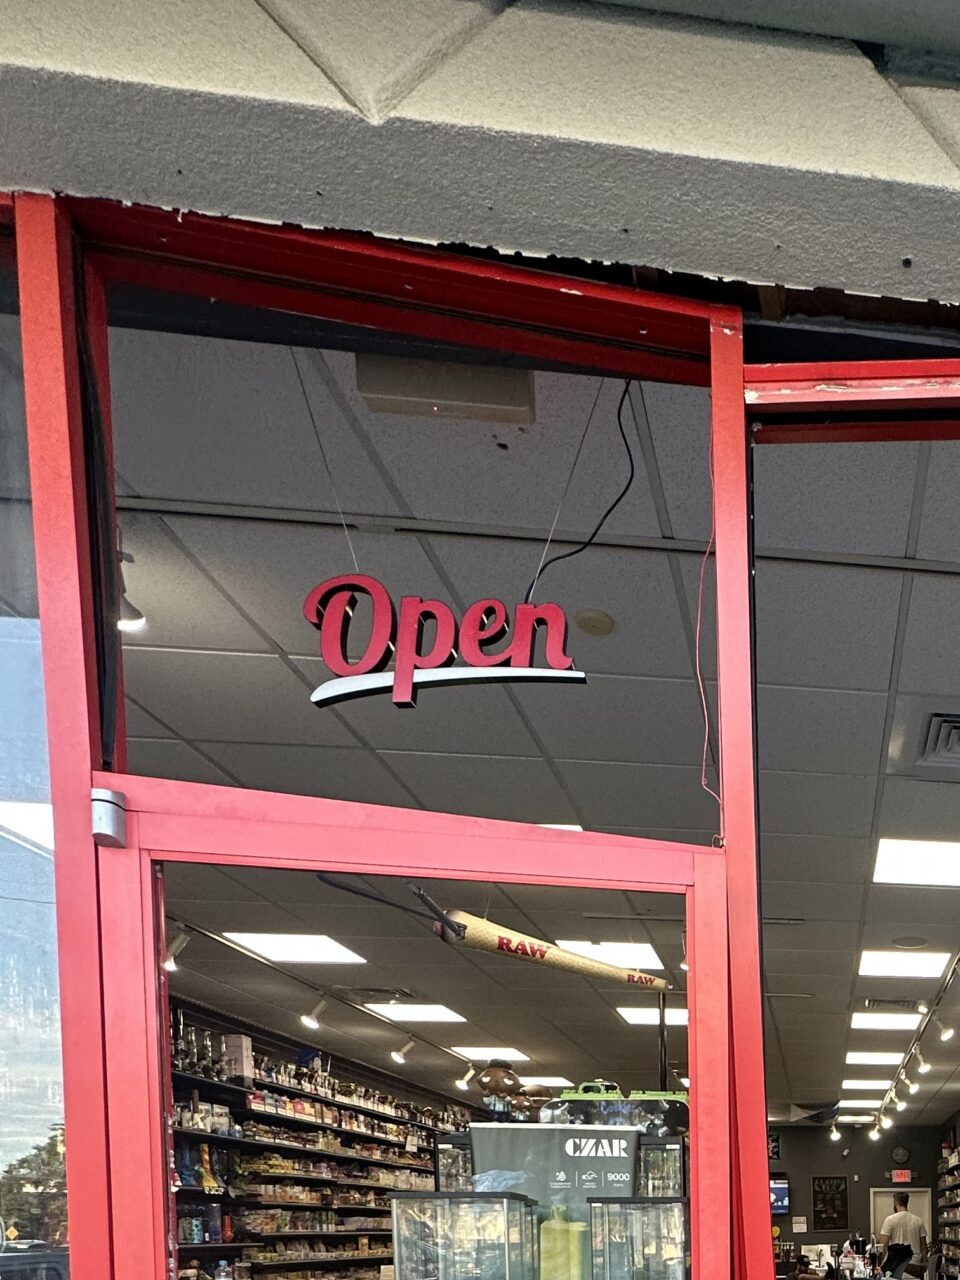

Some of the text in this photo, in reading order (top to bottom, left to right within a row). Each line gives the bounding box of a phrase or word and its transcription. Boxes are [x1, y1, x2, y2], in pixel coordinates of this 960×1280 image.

[303, 573, 575, 706] Open
[497, 936, 548, 960] RAW
[627, 974, 656, 986] RAW
[565, 1138, 628, 1158] CZAR
[607, 1173, 630, 1181] 9000
